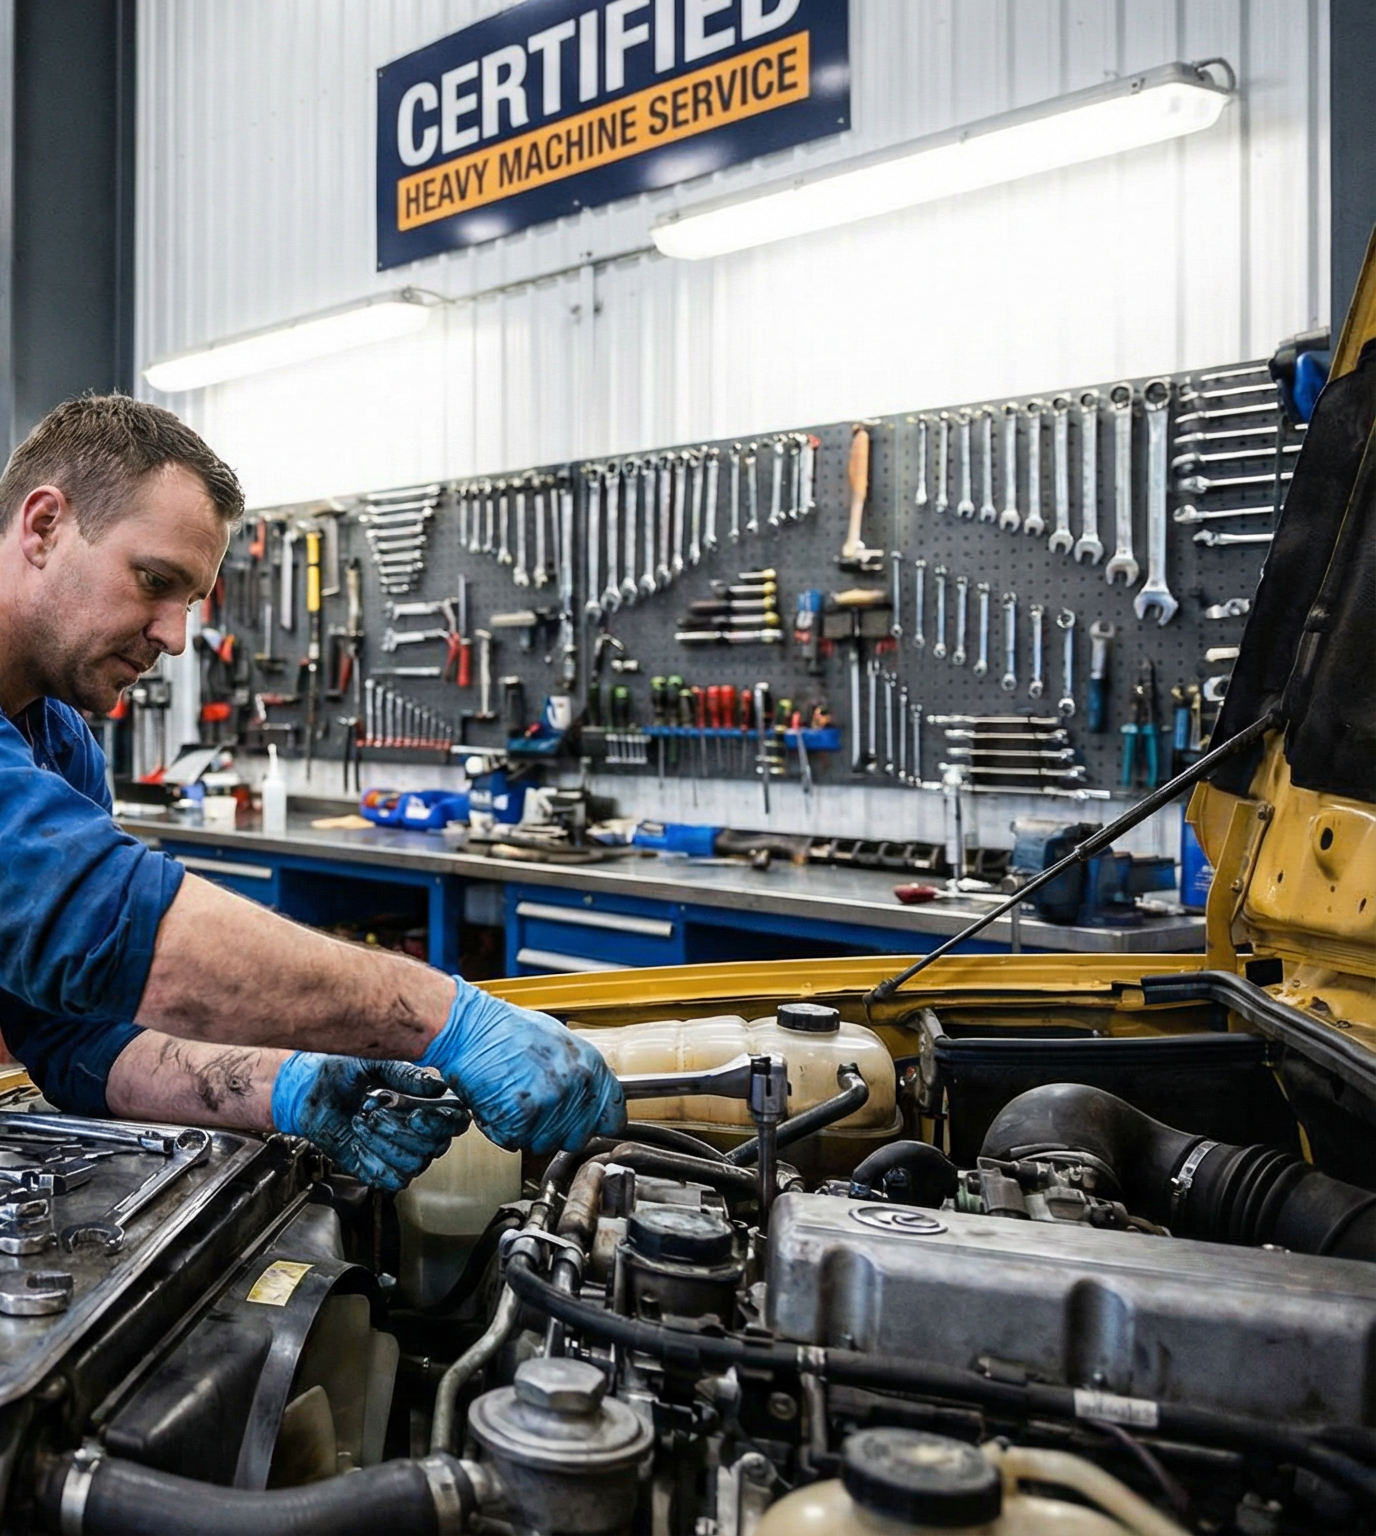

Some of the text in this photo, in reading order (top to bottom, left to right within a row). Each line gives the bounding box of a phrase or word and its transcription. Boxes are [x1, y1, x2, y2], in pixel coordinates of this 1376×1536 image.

[405, 47, 798, 219] HEAVY MACHINE SERVICE
